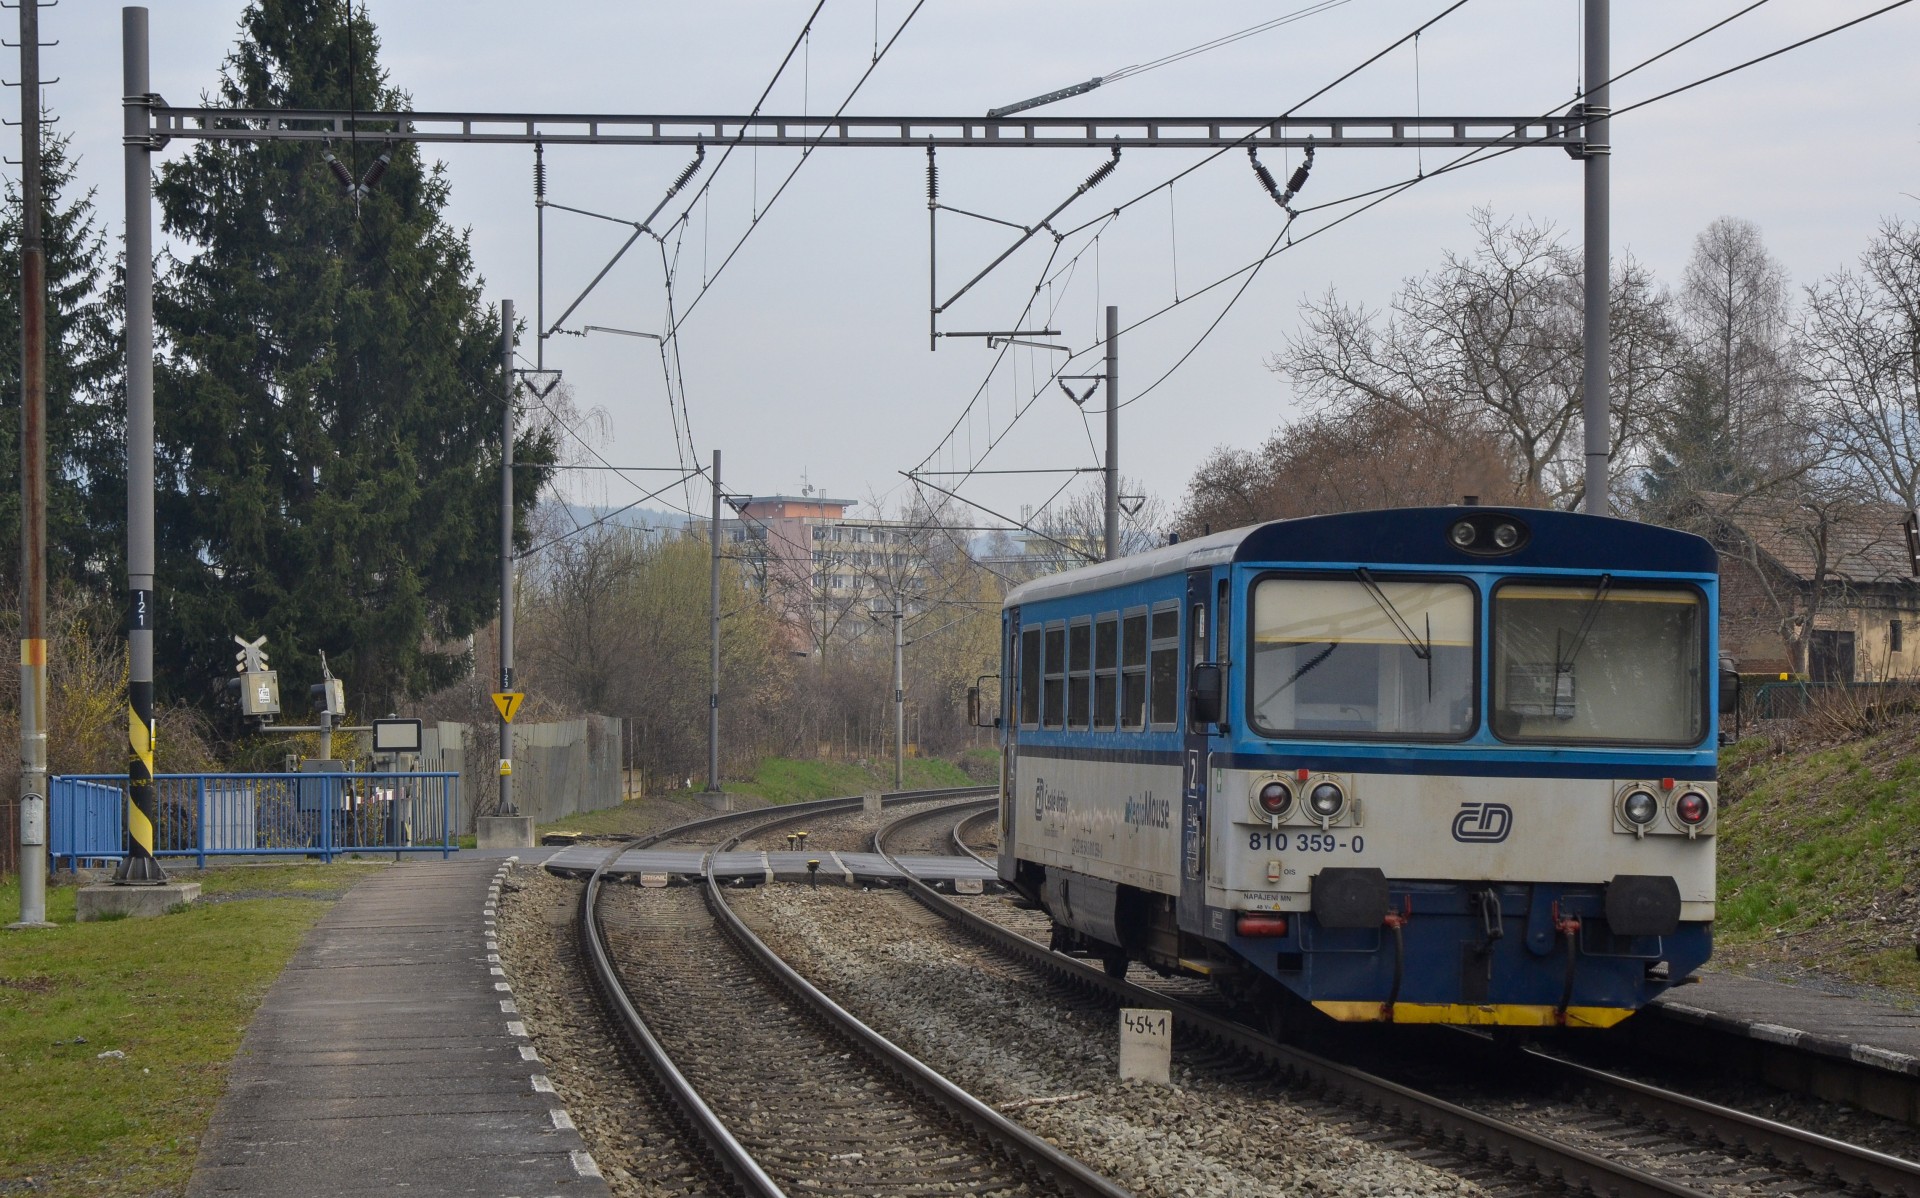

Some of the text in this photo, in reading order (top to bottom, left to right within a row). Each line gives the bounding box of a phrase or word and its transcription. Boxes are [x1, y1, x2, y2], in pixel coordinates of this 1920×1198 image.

[138, 590, 146, 626] 121
[502, 695, 514, 717] 7
[1190, 757, 1196, 790] 2
[1126, 790, 1170, 833] RegioMouse
[1451, 802, 1513, 843] ČD
[1249, 832, 1364, 854] 810 359-0
[1283, 868, 1296, 876] OIS
[1124, 1012, 1165, 1037] 454.1
